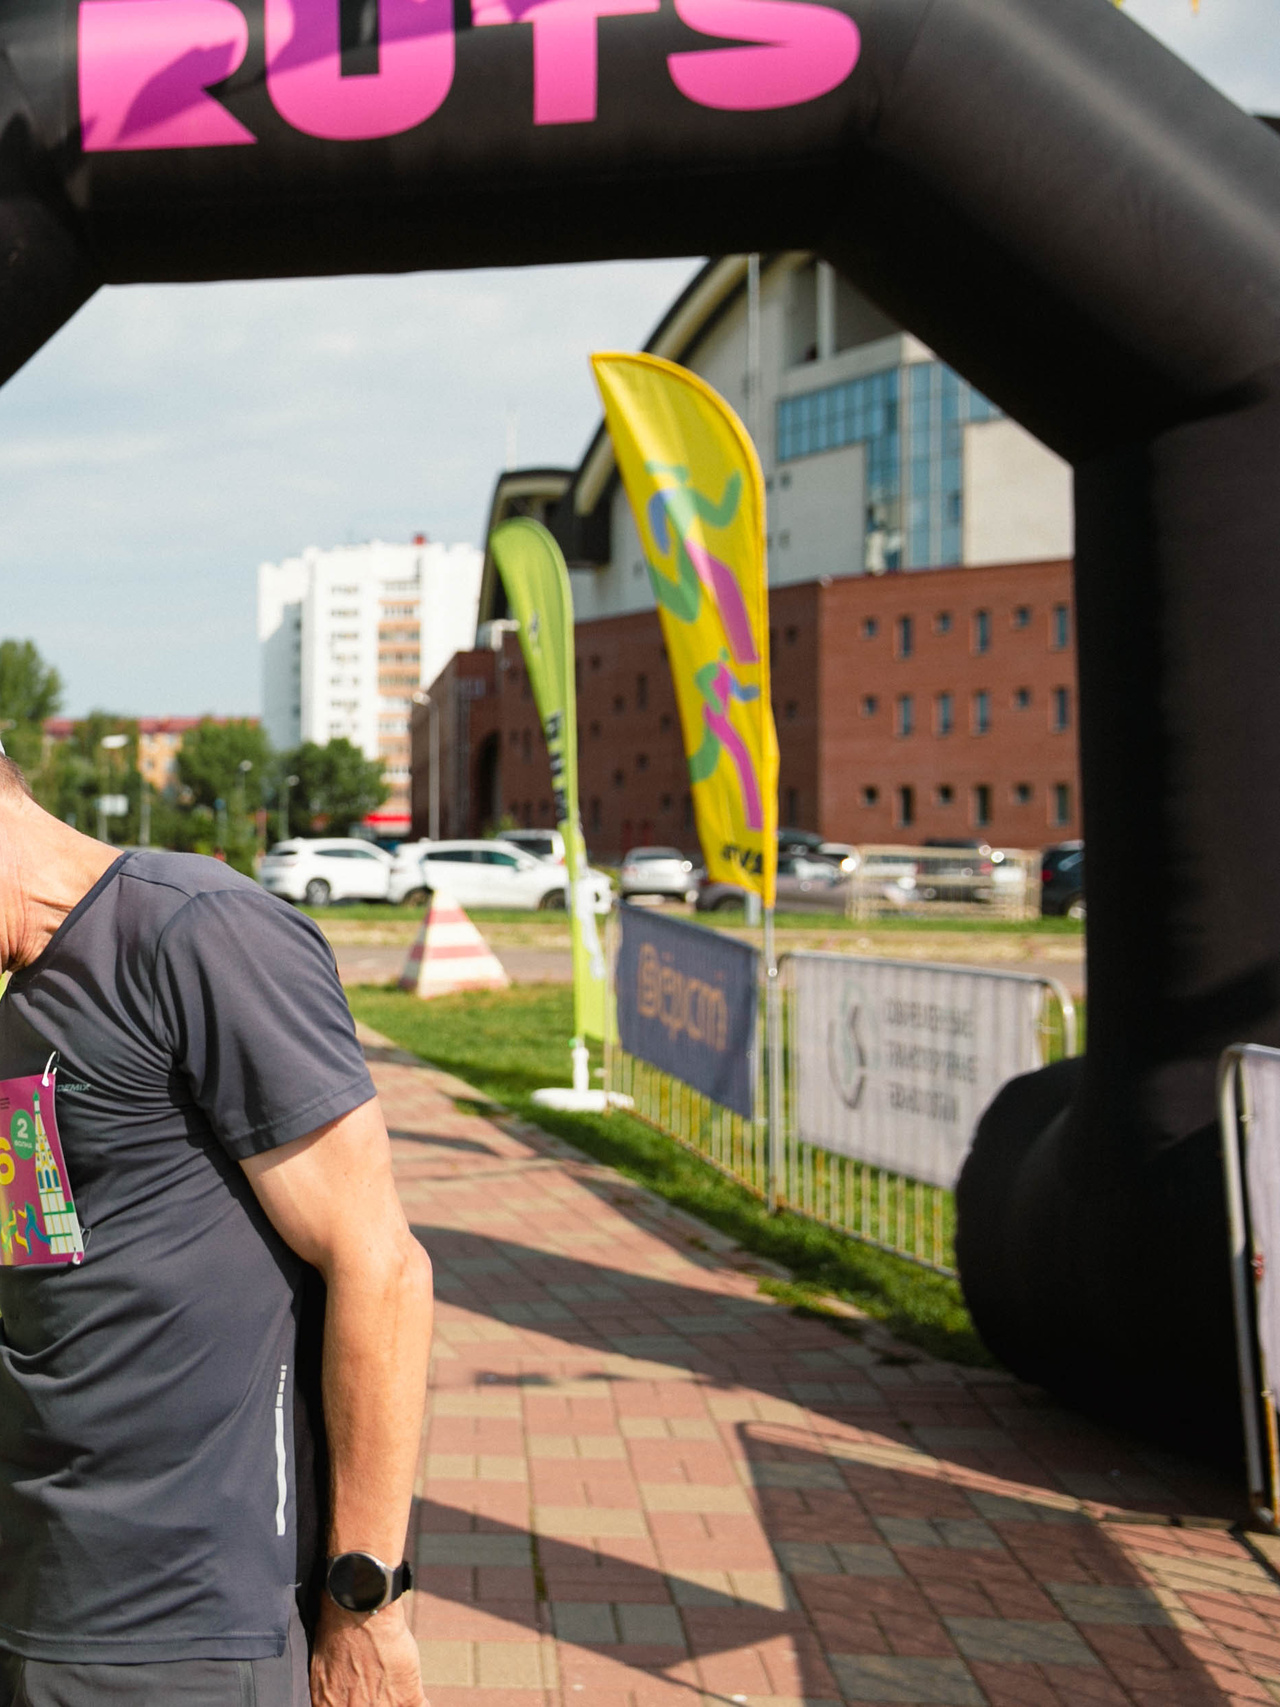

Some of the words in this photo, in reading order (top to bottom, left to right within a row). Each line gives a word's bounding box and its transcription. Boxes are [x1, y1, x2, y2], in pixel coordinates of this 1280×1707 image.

[77, 0, 862, 152] RUTS
[56, 1082, 91, 1093] DEMIX
[17, 1118, 29, 1139] 2
